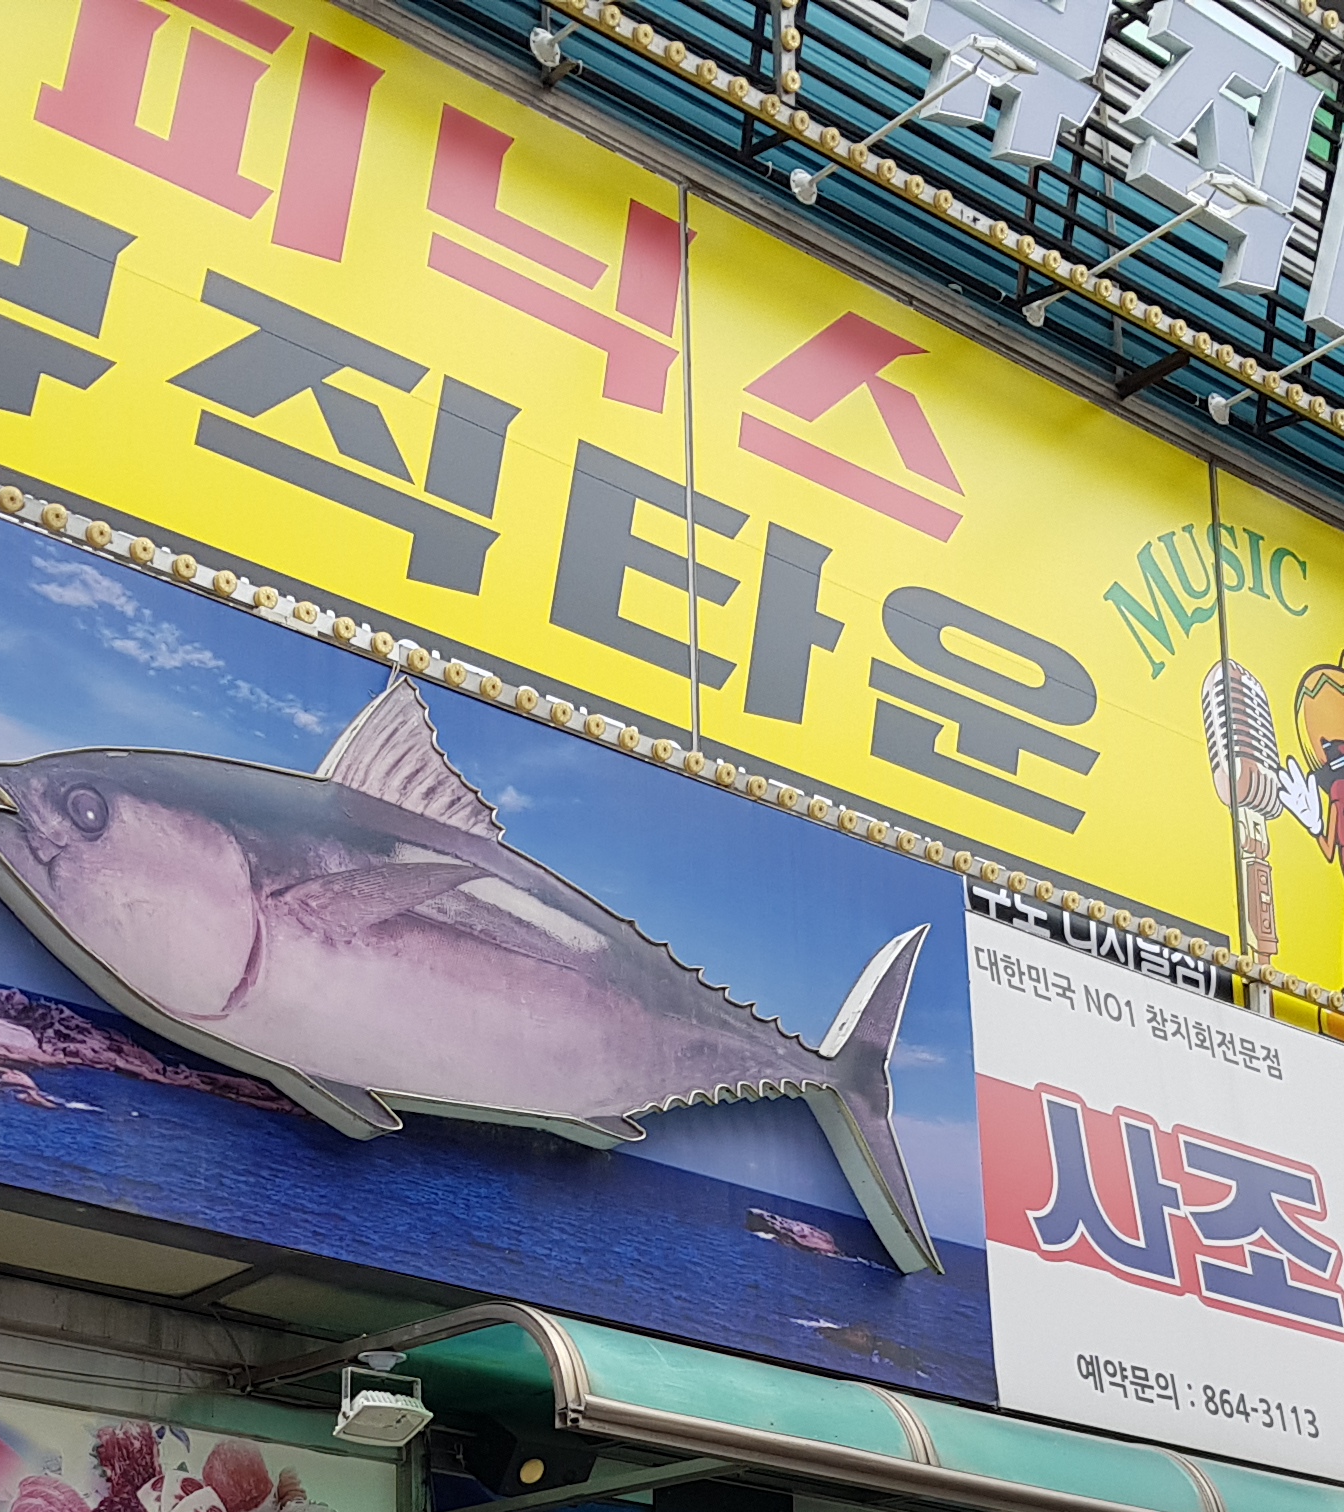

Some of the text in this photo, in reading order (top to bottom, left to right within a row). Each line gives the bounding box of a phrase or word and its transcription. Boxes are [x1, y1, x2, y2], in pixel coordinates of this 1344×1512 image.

[33, 0, 966, 543] 피닉스
[1102, 514, 1311, 680] MUSIC
[973, 945, 1284, 1082] 대한민국 NO1 참치회전문점
[1076, 1352, 1322, 1440] 예약문의 864-3113
